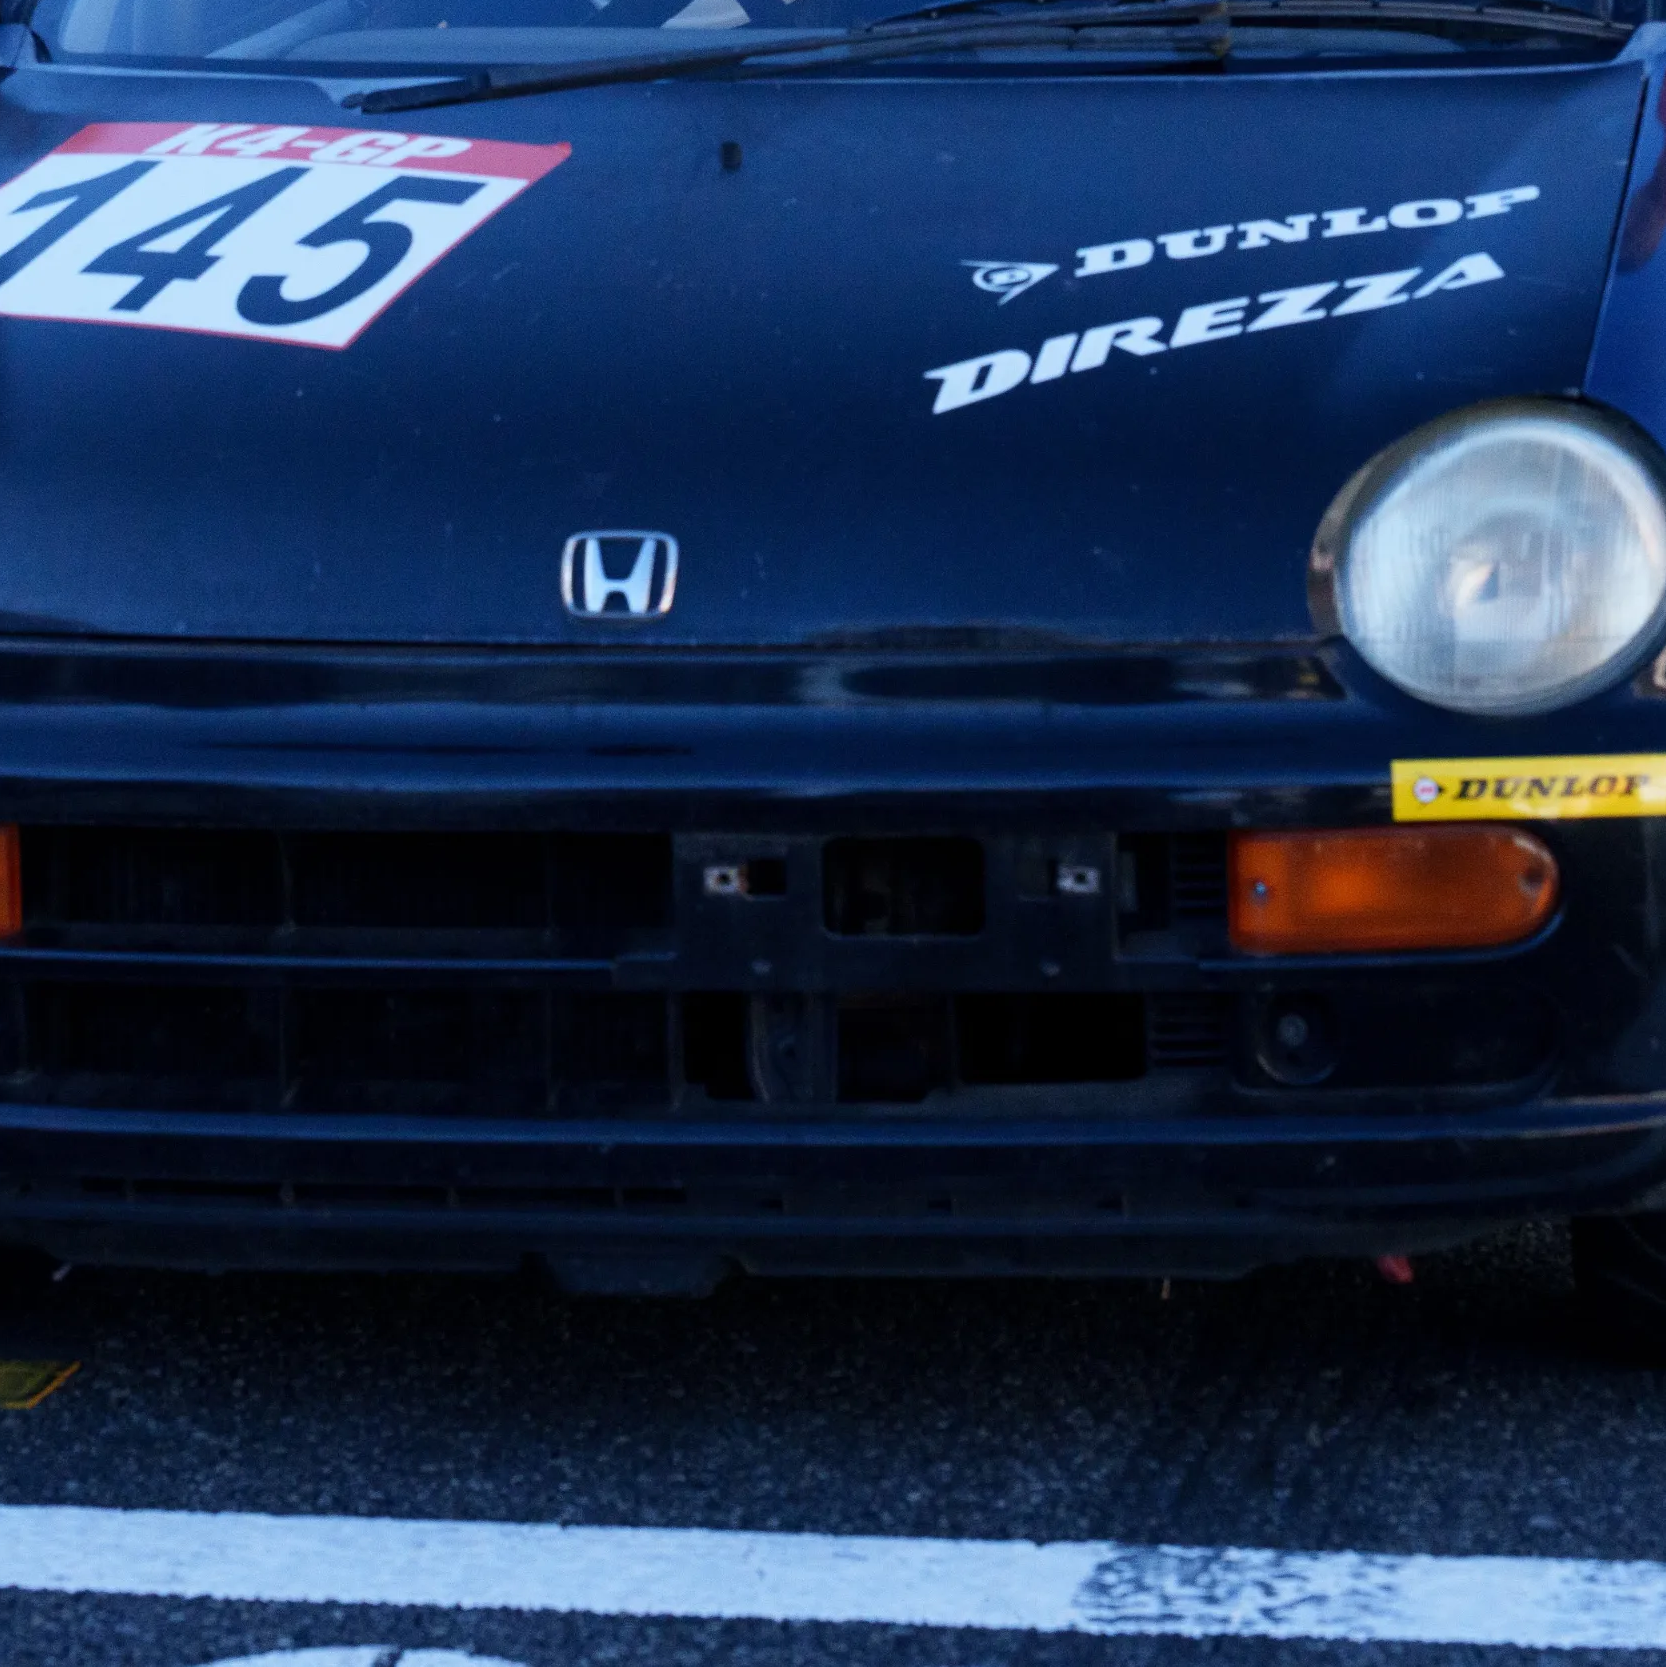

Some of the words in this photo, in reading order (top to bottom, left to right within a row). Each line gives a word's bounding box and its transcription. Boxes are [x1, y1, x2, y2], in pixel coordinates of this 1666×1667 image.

[140, 122, 475, 166] K4-GP
[1074, 184, 1540, 277] DUNLOP
[923, 251, 1505, 414] DIREZZA
[1452, 774, 1651, 802] DUNLOP
